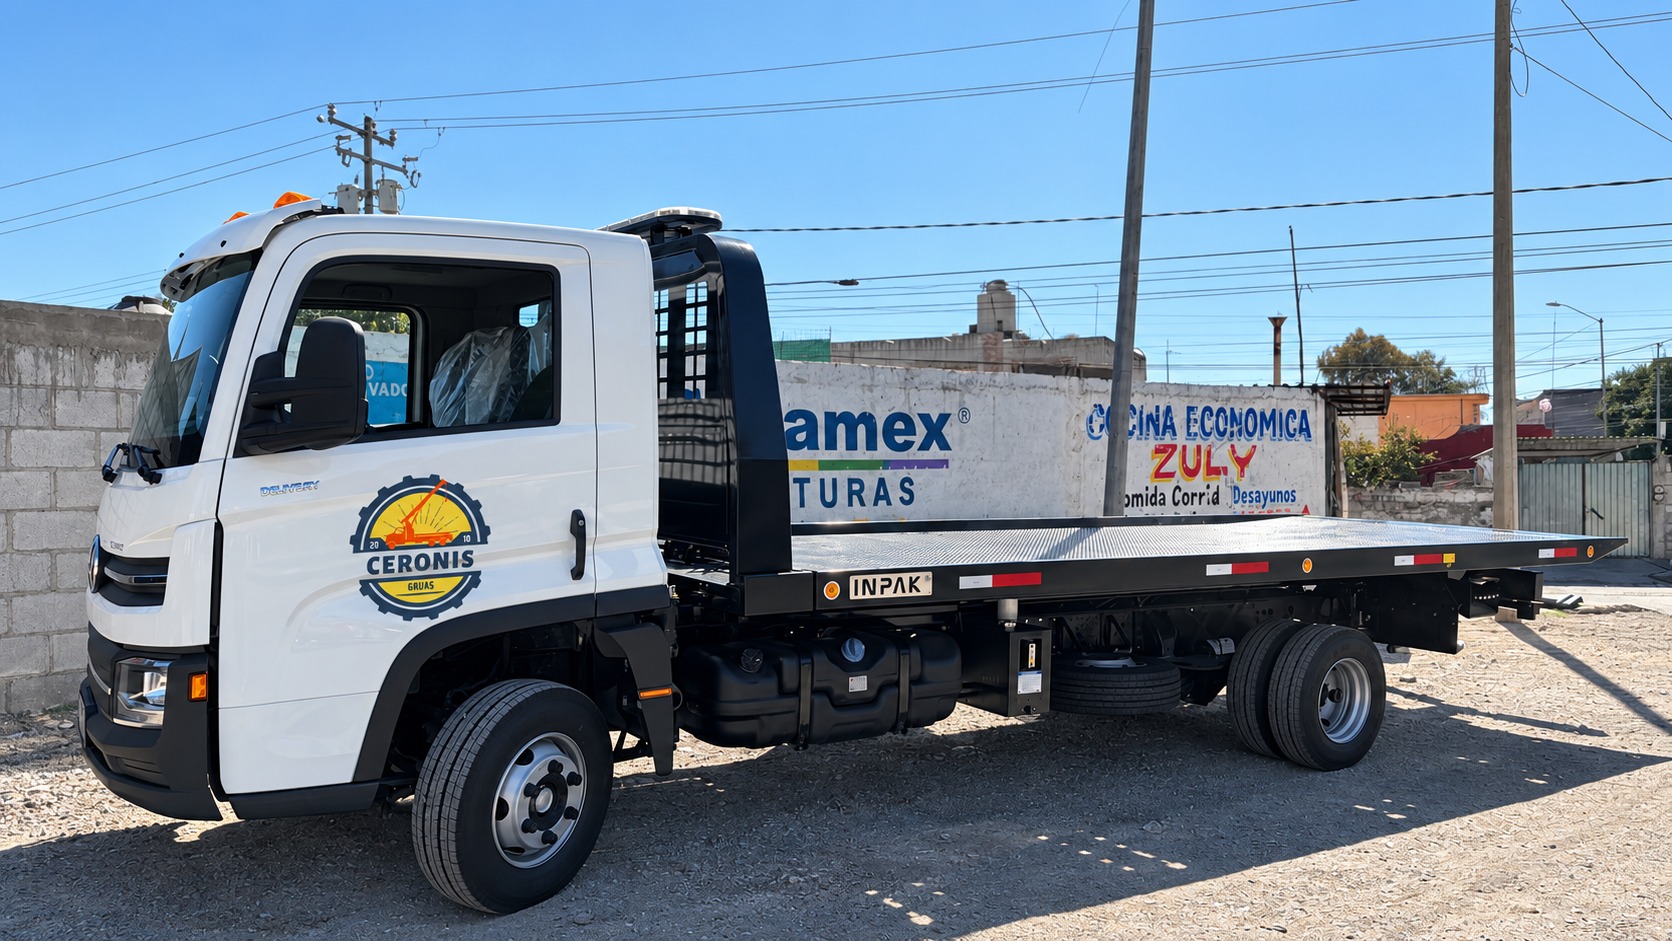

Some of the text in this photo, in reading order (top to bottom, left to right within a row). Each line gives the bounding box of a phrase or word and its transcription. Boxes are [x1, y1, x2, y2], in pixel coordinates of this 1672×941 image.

[784, 408, 953, 452] amex
[1185, 405, 1312, 441] ECONOMICA
[1149, 443, 1257, 483] ZULY
[793, 476, 915, 508] TURAS
[1233, 485, 1297, 509] Desayunos
[369, 541, 379, 550] 20
[462, 534, 471, 543] 10
[366, 550, 474, 575] CERONIS
[407, 580, 435, 591] GRUAS
[854, 575, 921, 597] INPAK
